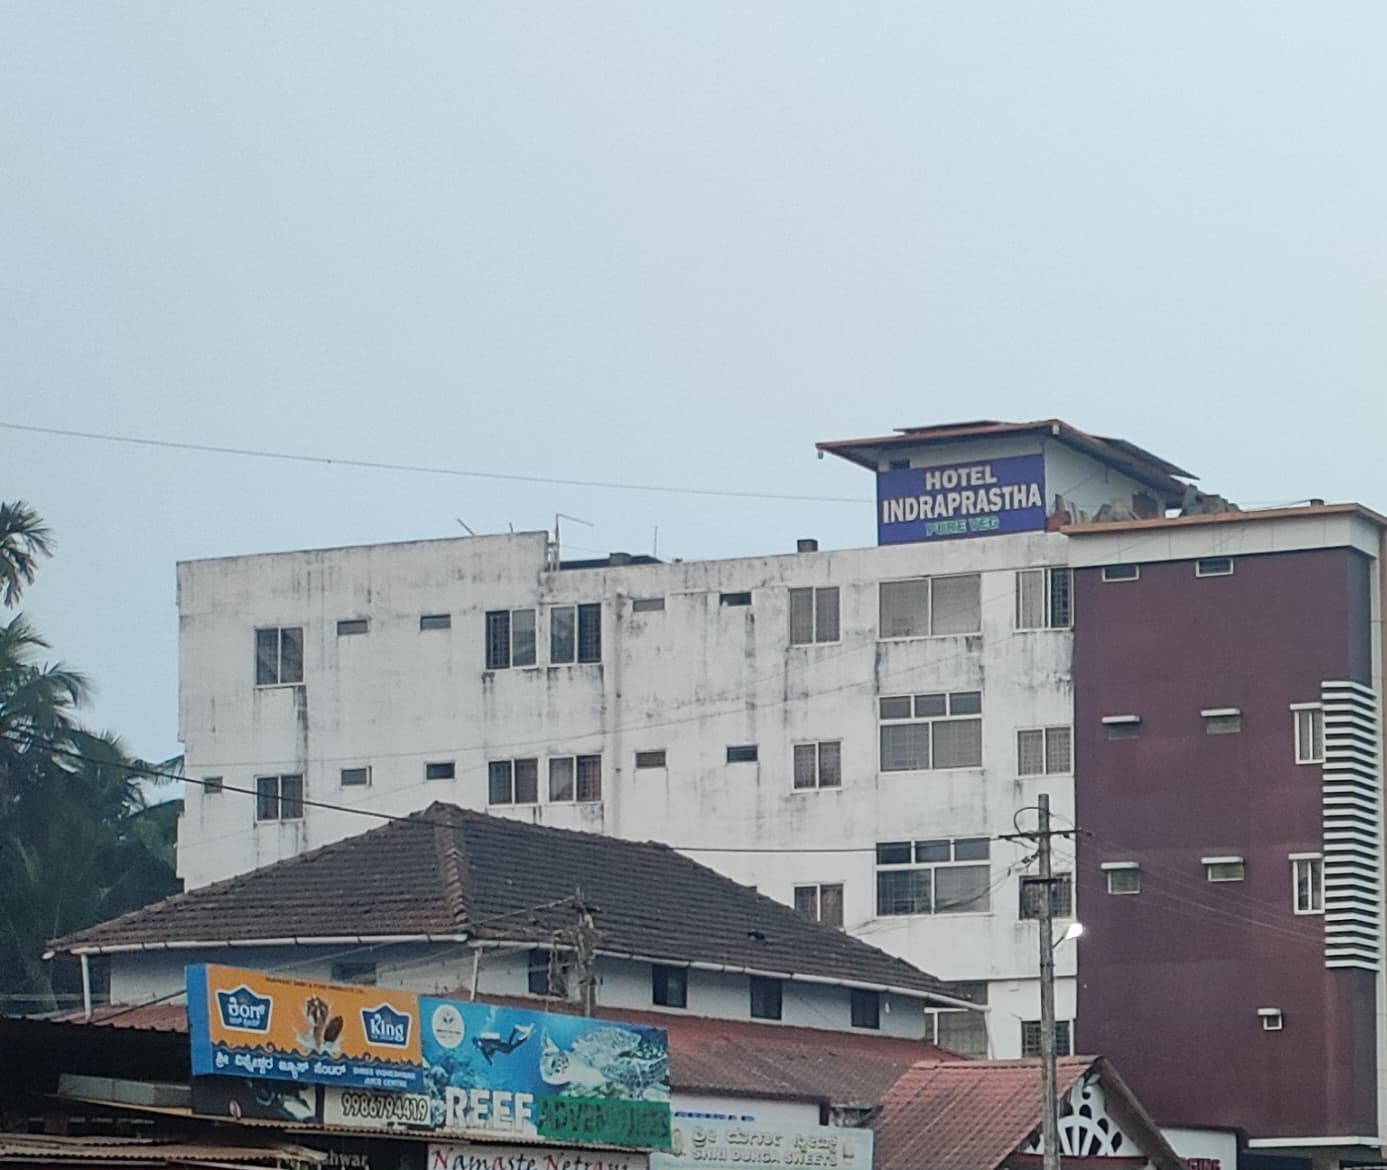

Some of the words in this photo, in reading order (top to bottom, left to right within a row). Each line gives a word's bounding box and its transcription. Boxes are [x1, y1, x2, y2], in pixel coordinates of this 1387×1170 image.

[926, 465, 998, 490] HOTEL
[883, 483, 1042, 523] INDRAPRASTHA
[926, 519, 967, 536] PURE
[969, 516, 999, 531] VEG
[342, 1092, 428, 1121] 9986794419
[445, 1086, 534, 1132] REEF
[731, 1151, 781, 1165] DURGA
[784, 1152, 838, 1168] SWEETS
